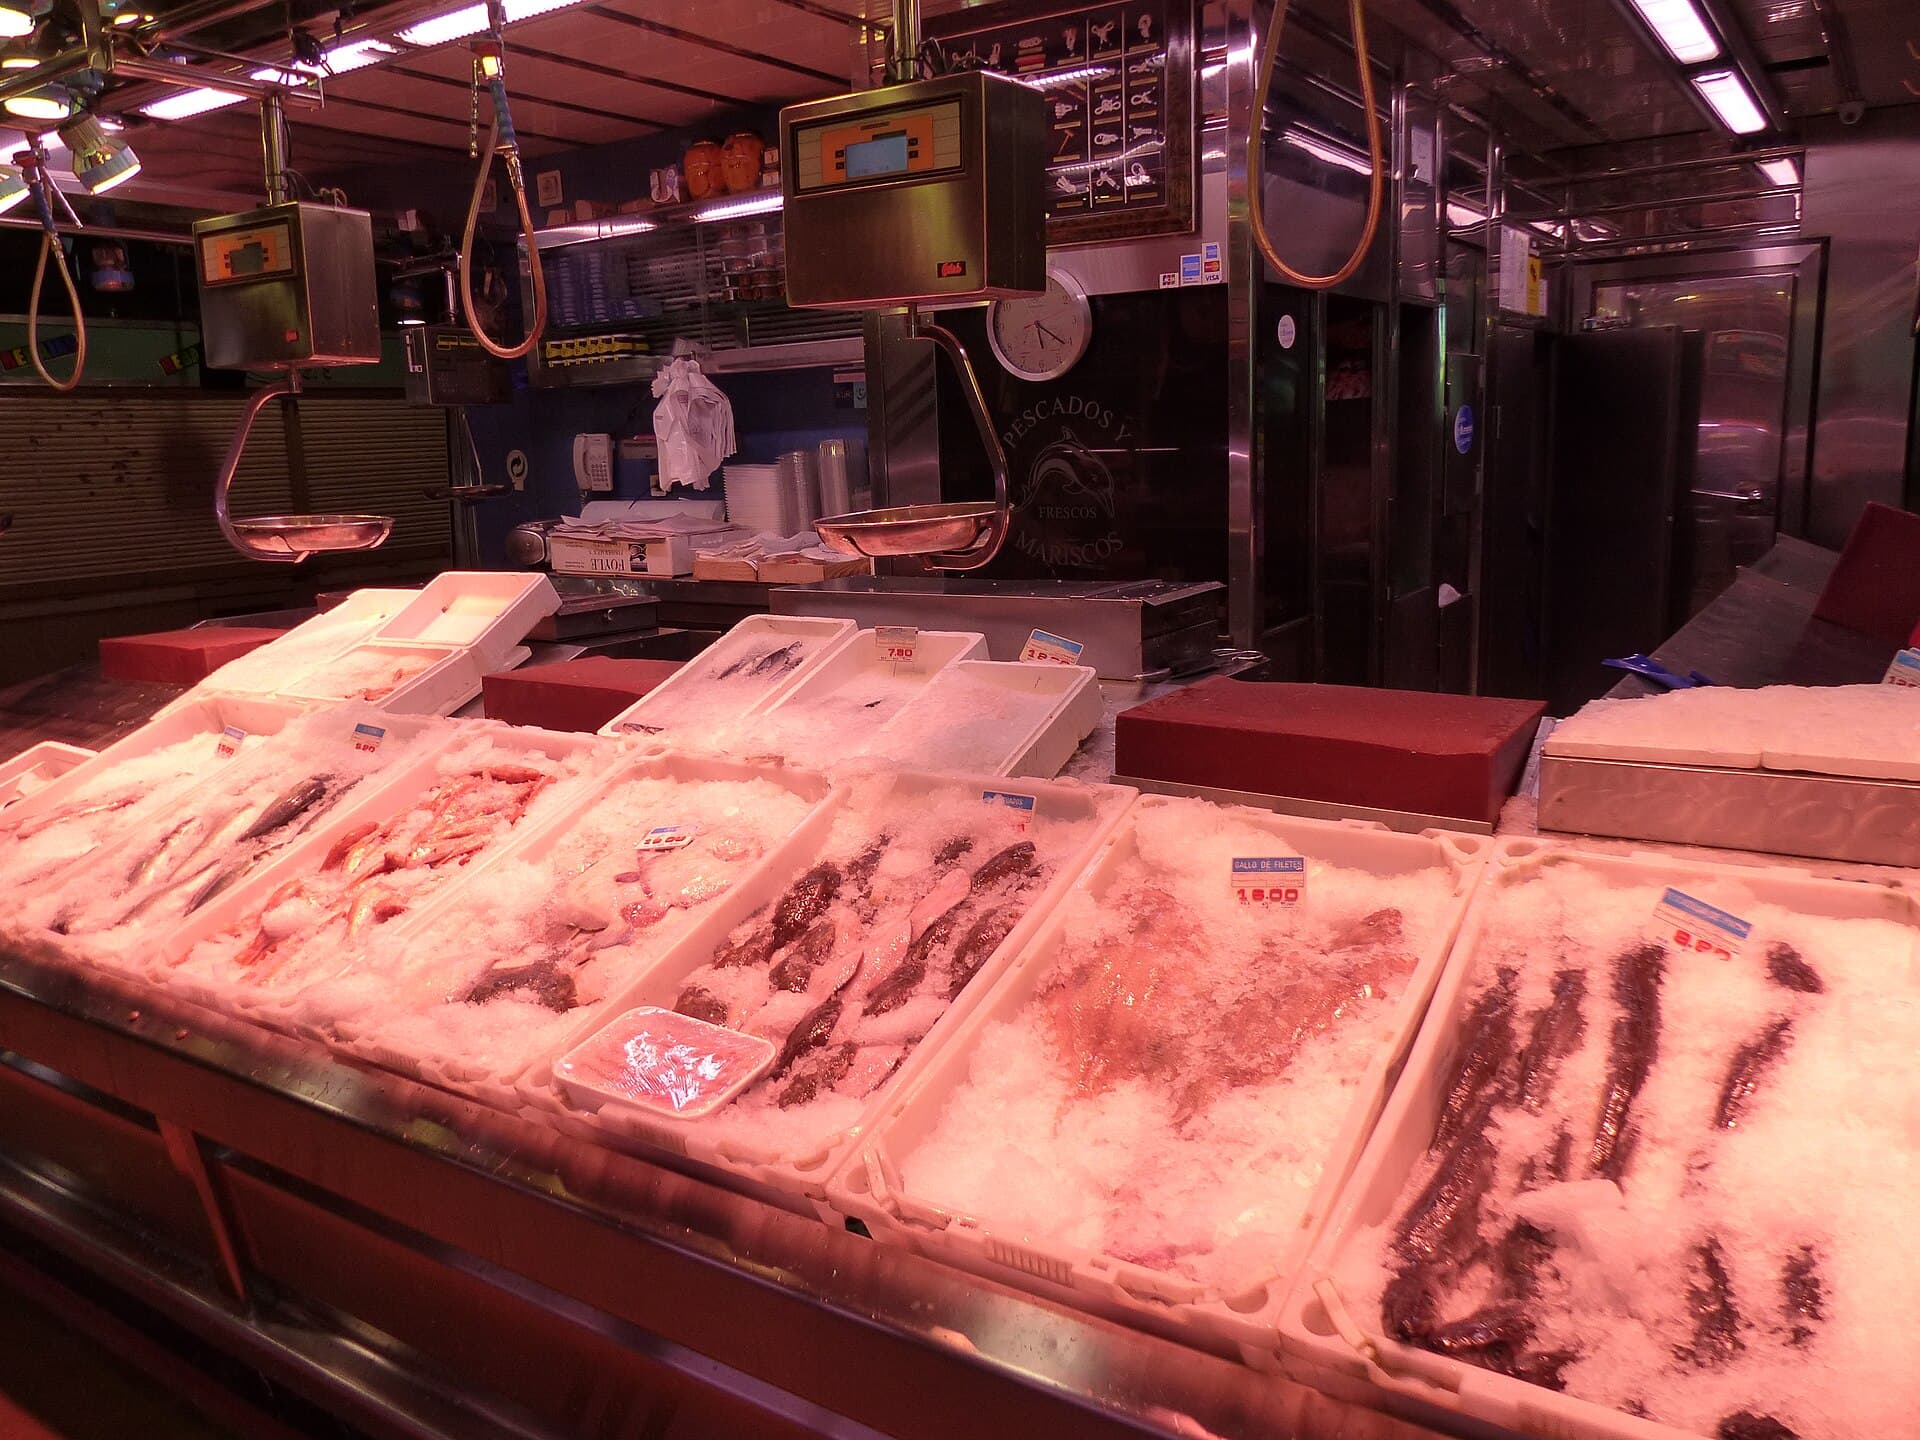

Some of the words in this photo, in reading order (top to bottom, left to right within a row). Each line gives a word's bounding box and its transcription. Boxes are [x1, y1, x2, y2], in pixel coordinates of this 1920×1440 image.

[1003, 396, 1113, 448] PESCADOS
[1115, 424, 1133, 441] Y
[1039, 506, 1097, 519] FRESCOS
[1015, 531, 1124, 567] MARISCOS
[591, 558, 625, 571] FOYLE
[887, 648, 913, 657] 7.80
[1234, 861, 1257, 869] GALLO
[1260, 861, 1271, 869] DE
[1274, 861, 1302, 869] FILETES
